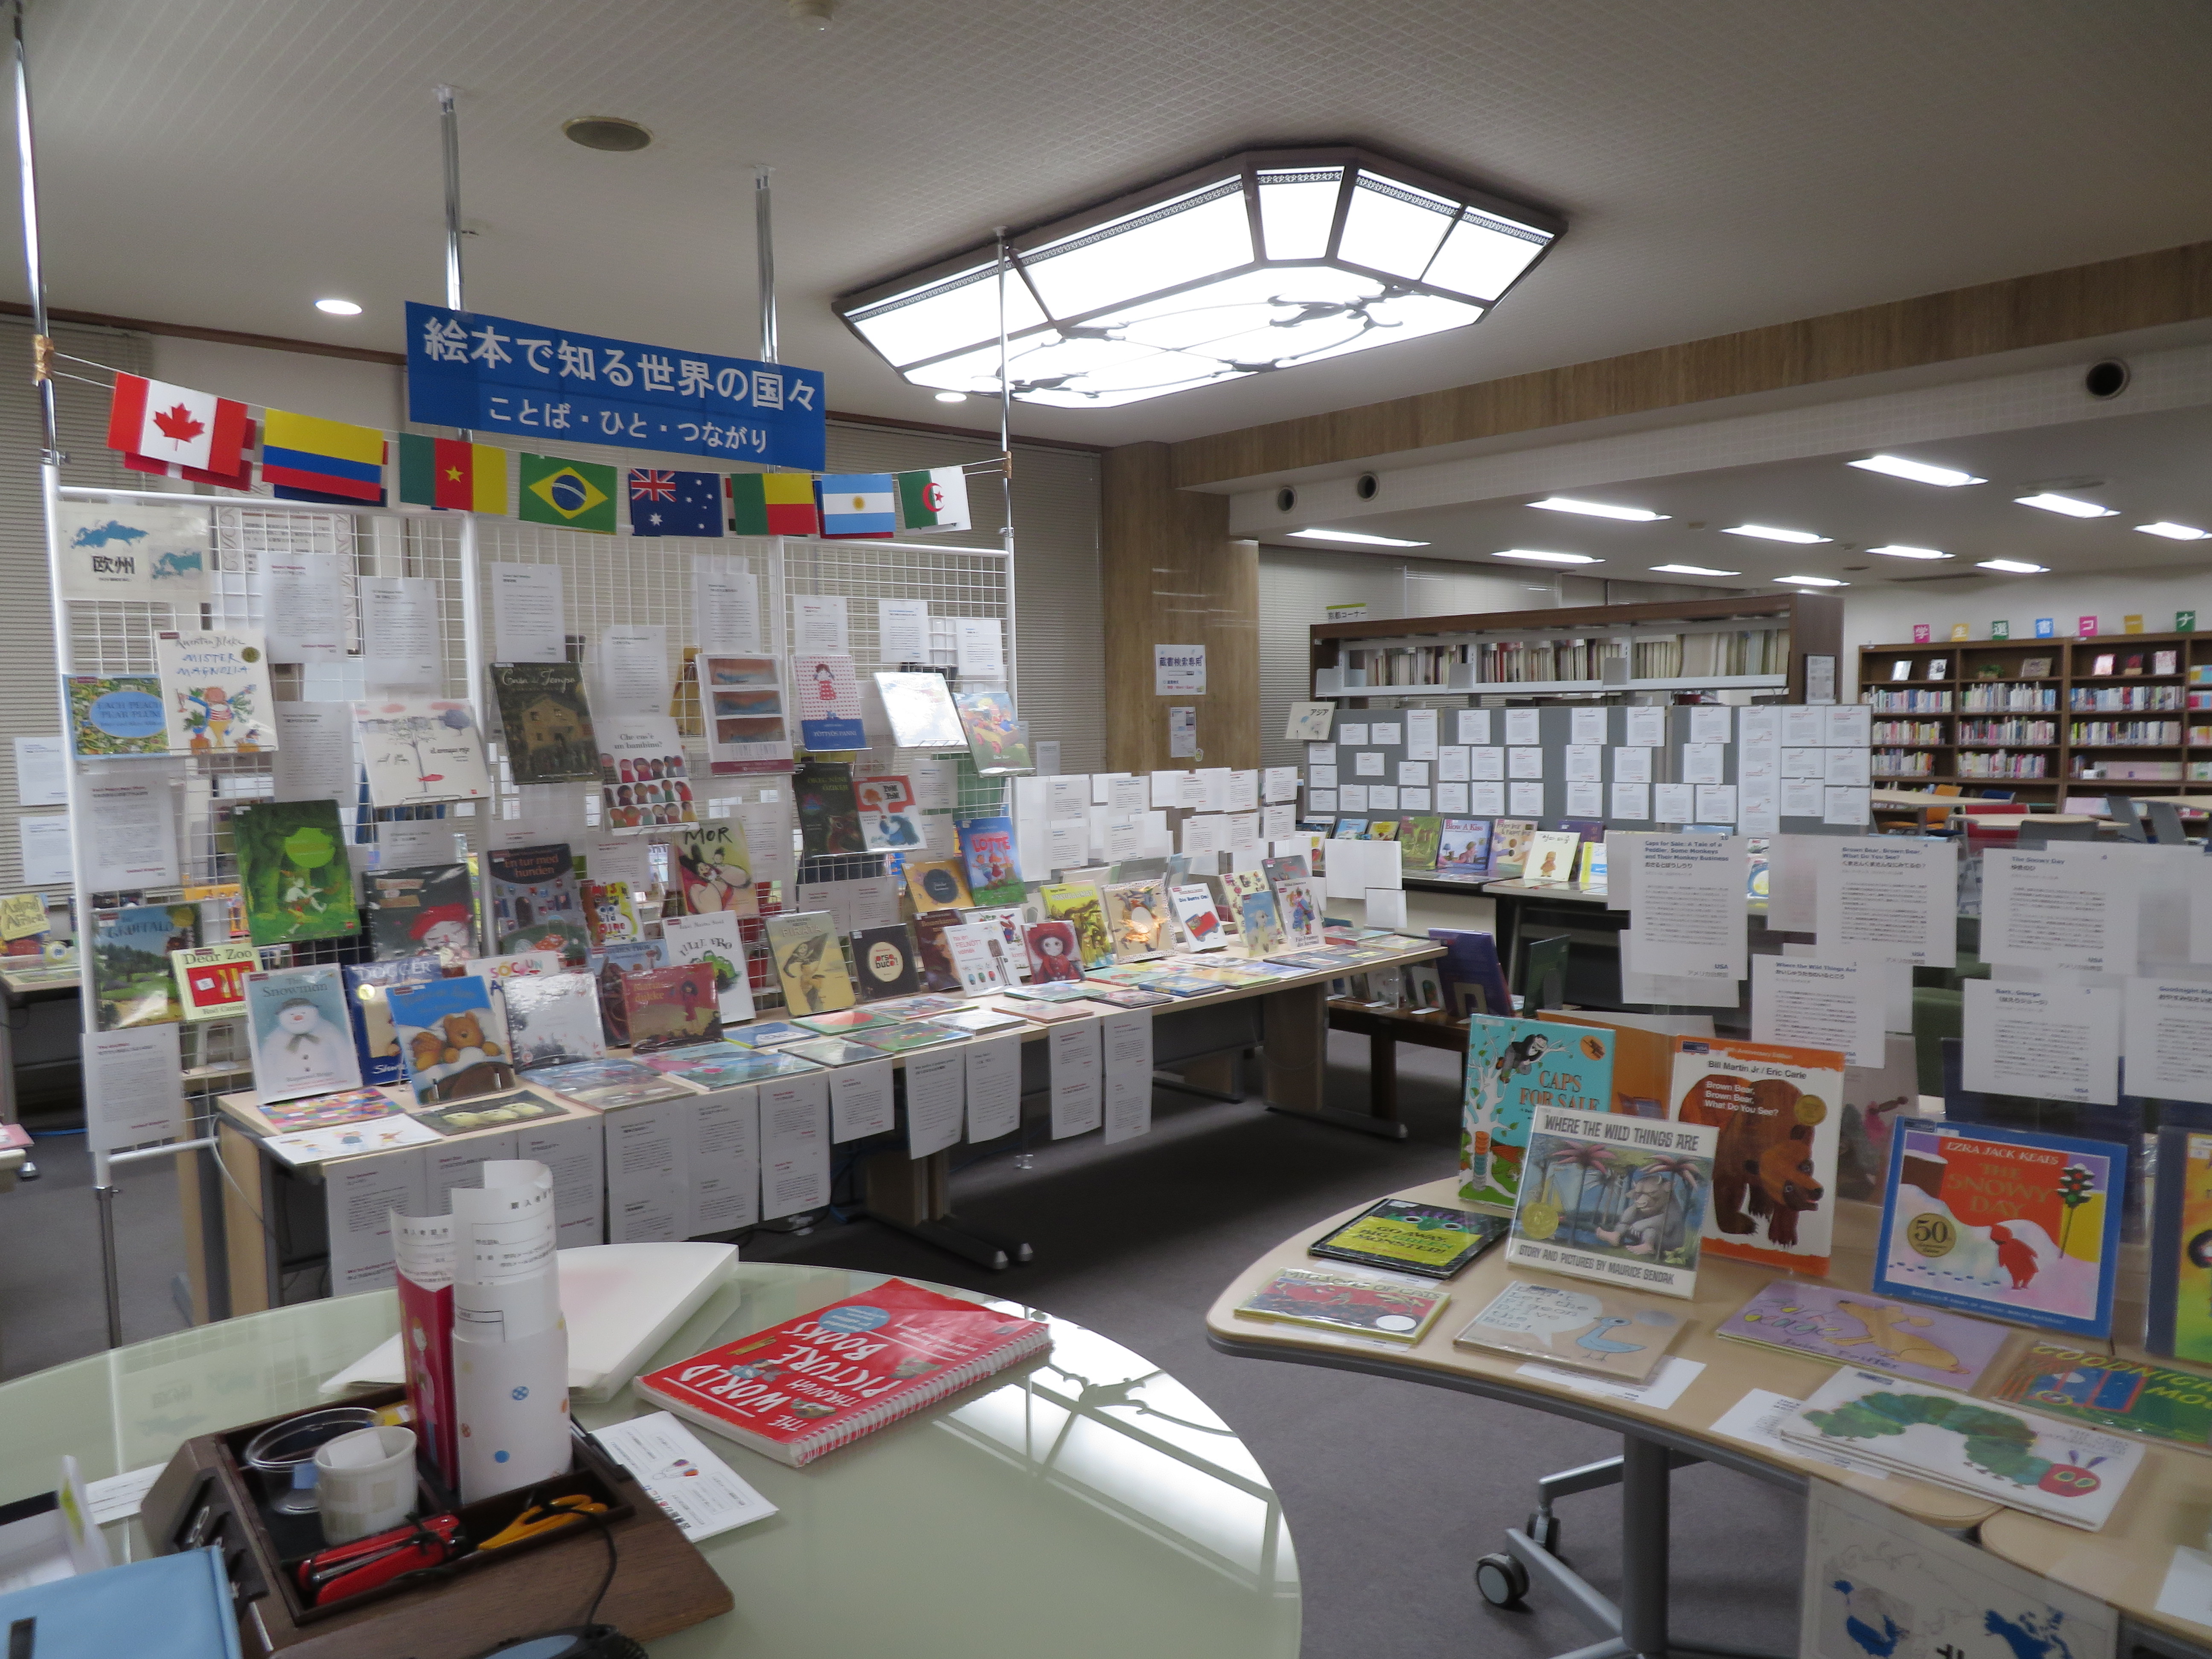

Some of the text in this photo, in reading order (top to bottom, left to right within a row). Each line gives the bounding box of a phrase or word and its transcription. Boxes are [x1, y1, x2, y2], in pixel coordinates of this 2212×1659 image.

[424, 317, 815, 412] 絵本で知る世界の国々
[489, 396, 767, 454] ことば・ひと・つながり
[91, 555, 135, 574] 欧州
[1328, 610, 1366, 620] 京都コーナー
[182, 653, 242, 663] MISTER
[1159, 657, 1202, 667] 蔵書検索専用
[176, 666, 248, 678] MAGNOLIA
[1445, 822, 1462, 830] Blow
[684, 827, 733, 844] MOR
[971, 836, 1011, 853] LOTTE
[782, 925, 822, 937] PIRATA
[225, 948, 253, 959] Zoo
[262, 983, 329, 998] Snowman
[1723, 1062, 1749, 1072] Martin
[1766, 1067, 1783, 1077] Eric
[1785, 1069, 1807, 1079] Carle
[1539, 1070, 1582, 1092] CAPS
[1706, 1081, 1755, 1094] Brown Bear,
[1519, 1087, 1600, 1111] FOR SALE
[1706, 1090, 1754, 1104] Brown Bear,
[1705, 1099, 1779, 1117] What Do You See?
[1545, 1115, 1700, 1151] WHERE THE WILD THINGS ARE
[1945, 1141, 2059, 1165] EZRA JACK KEATS
[1979, 1162, 2025, 1180] THE
[1947, 1173, 2058, 1203] SNOWY
[1969, 1195, 2028, 1219] DAY
[1359, 1229, 1390, 1237] BIG
[1914, 1219, 1949, 1243] 50
[1519, 1244, 1675, 1285] STORY AND PICTURES BY MAURICE SENDAK
[1372, 1284, 1397, 1292] OF
[1400, 1288, 1441, 1301] CATS
[780, 1321, 889, 1361] BOOKS
[767, 1344, 902, 1398] PICTURE
[681, 1364, 792, 1413] WORLD
[785, 1378, 862, 1407] THROUGH
[767, 1414, 808, 1432] THE
